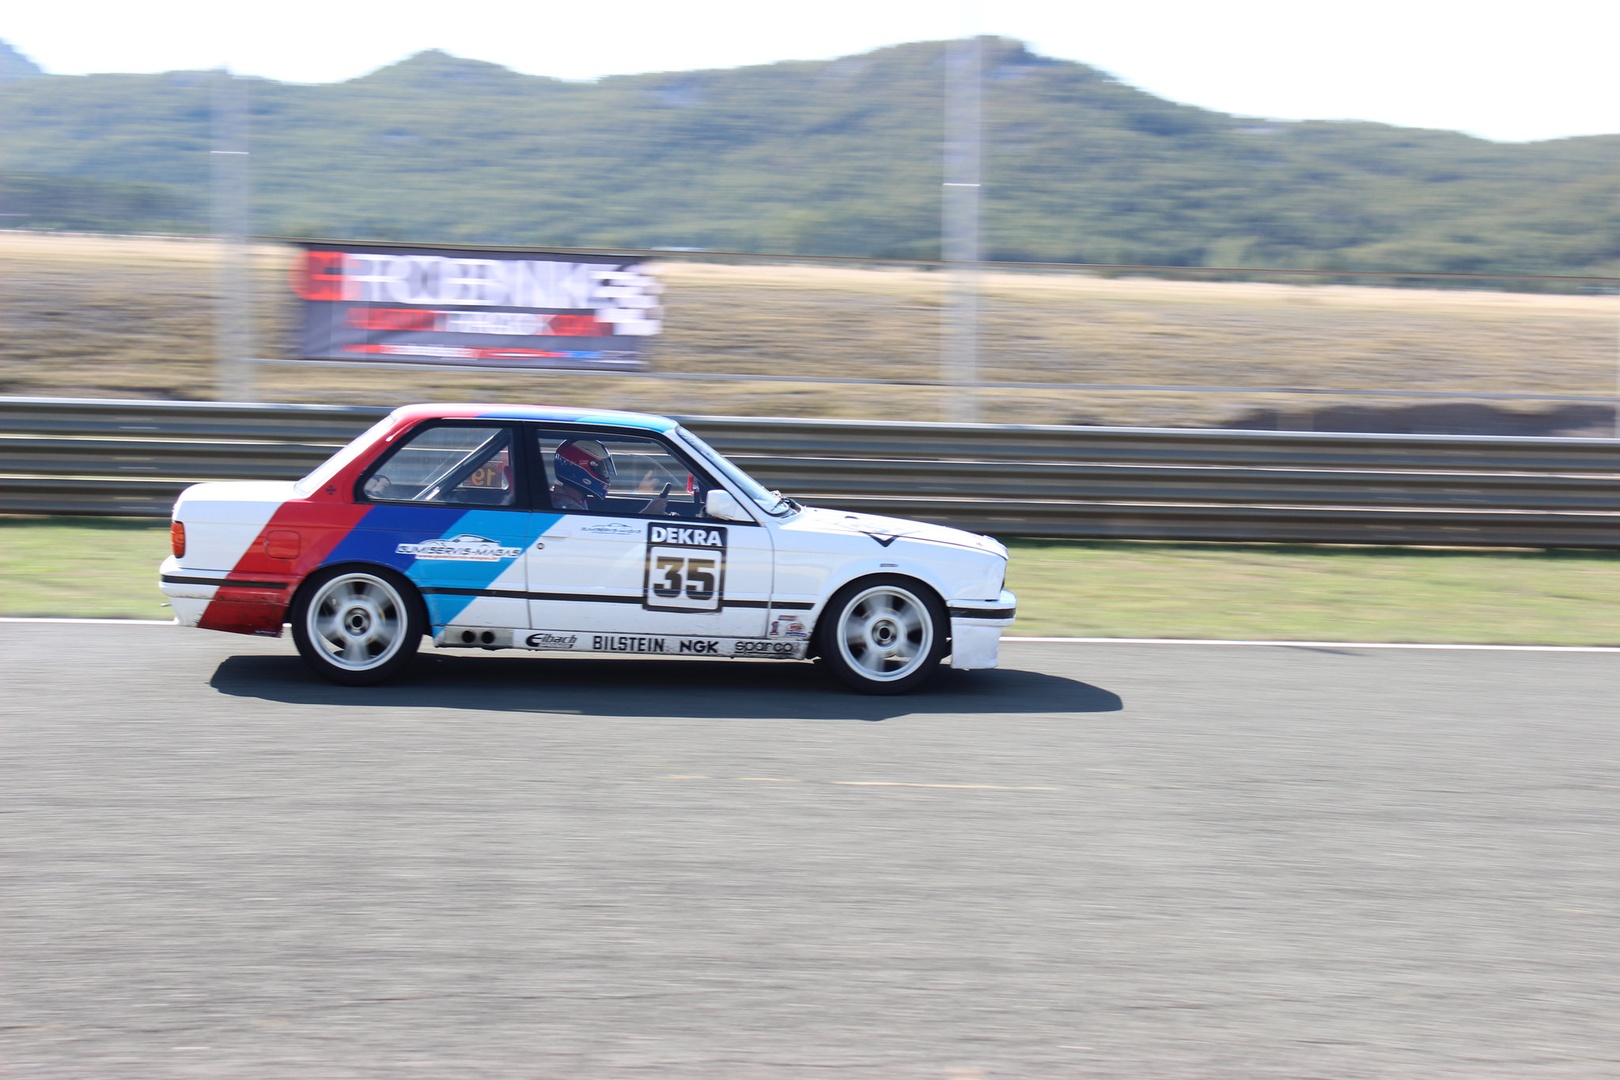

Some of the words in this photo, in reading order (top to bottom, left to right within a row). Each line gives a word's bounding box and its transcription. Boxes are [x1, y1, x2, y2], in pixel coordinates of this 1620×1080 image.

[651, 526, 723, 546] DEKRA
[653, 555, 716, 601] 35
[526, 633, 578, 648] Eibach
[592, 635, 666, 653] BILSTEIN
[680, 640, 719, 653] NGK
[734, 641, 793, 655] sparco
